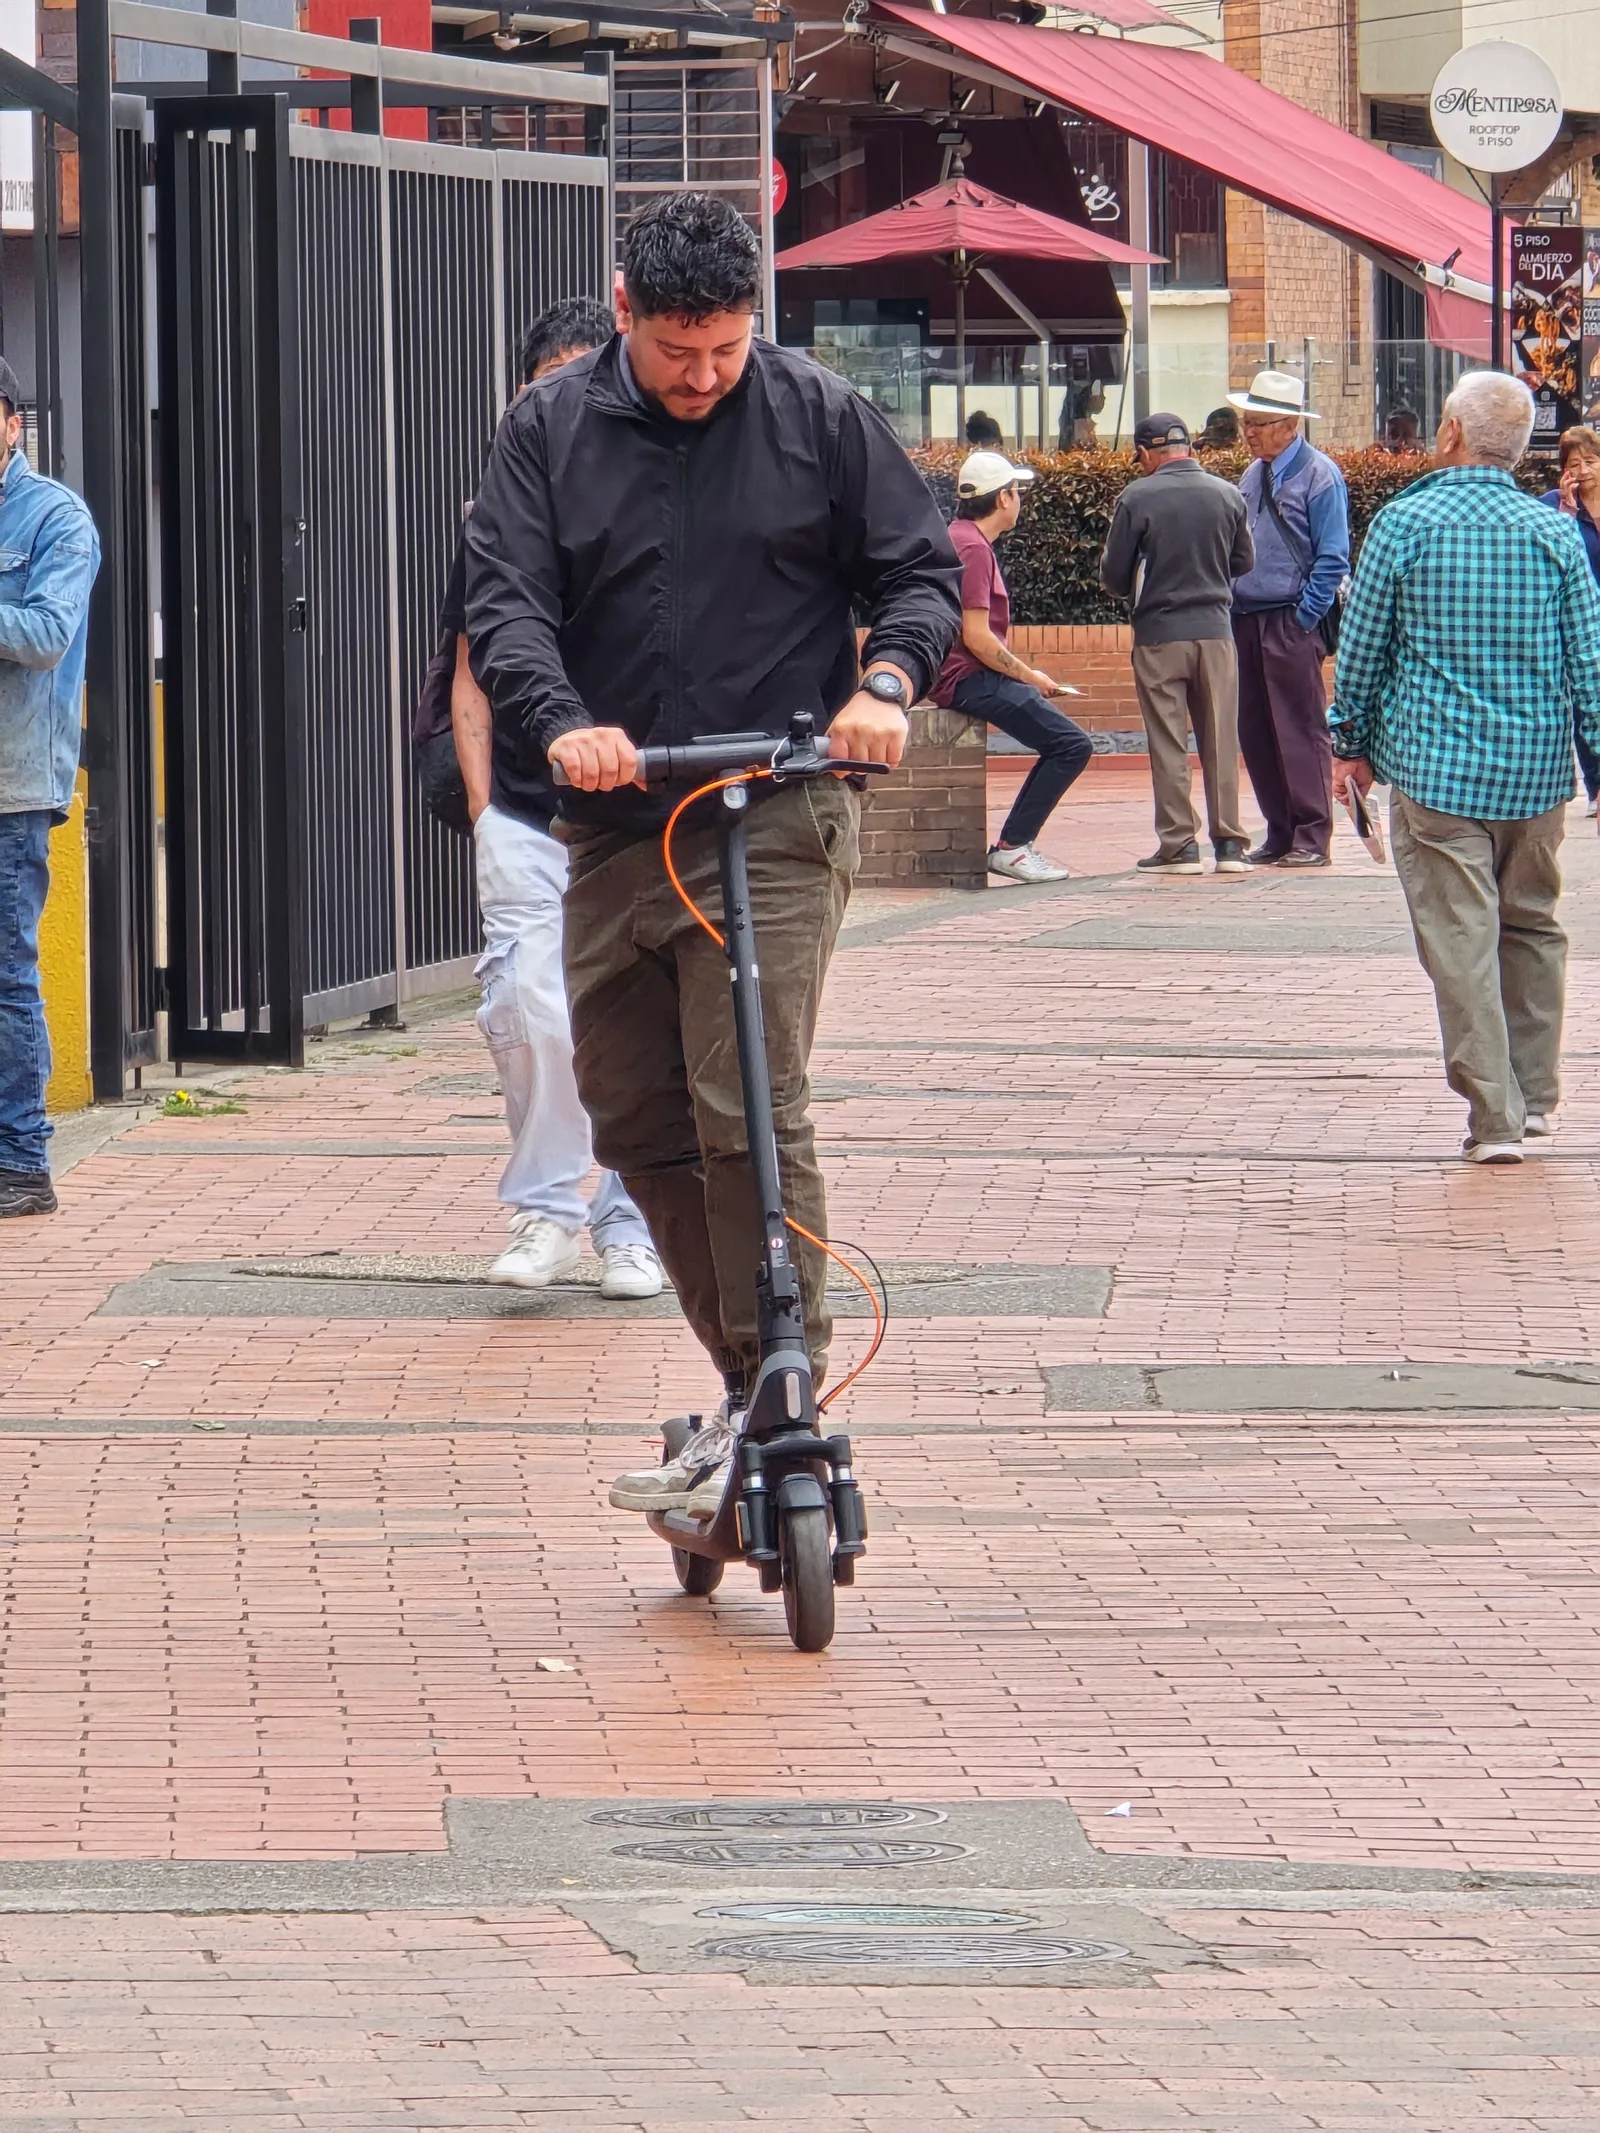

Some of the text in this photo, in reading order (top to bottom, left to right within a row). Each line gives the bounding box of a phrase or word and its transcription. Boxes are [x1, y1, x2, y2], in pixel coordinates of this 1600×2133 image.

[1435, 88, 1557, 116] MENTIROSA
[1469, 125, 1520, 134] ROOFTOP
[1478, 136, 1513, 146] 5 PISO
[1525, 235, 1550, 246] PISO
[1519, 252, 1572, 263] ALMUERZO
[1519, 262, 1564, 280] DEL DIA
